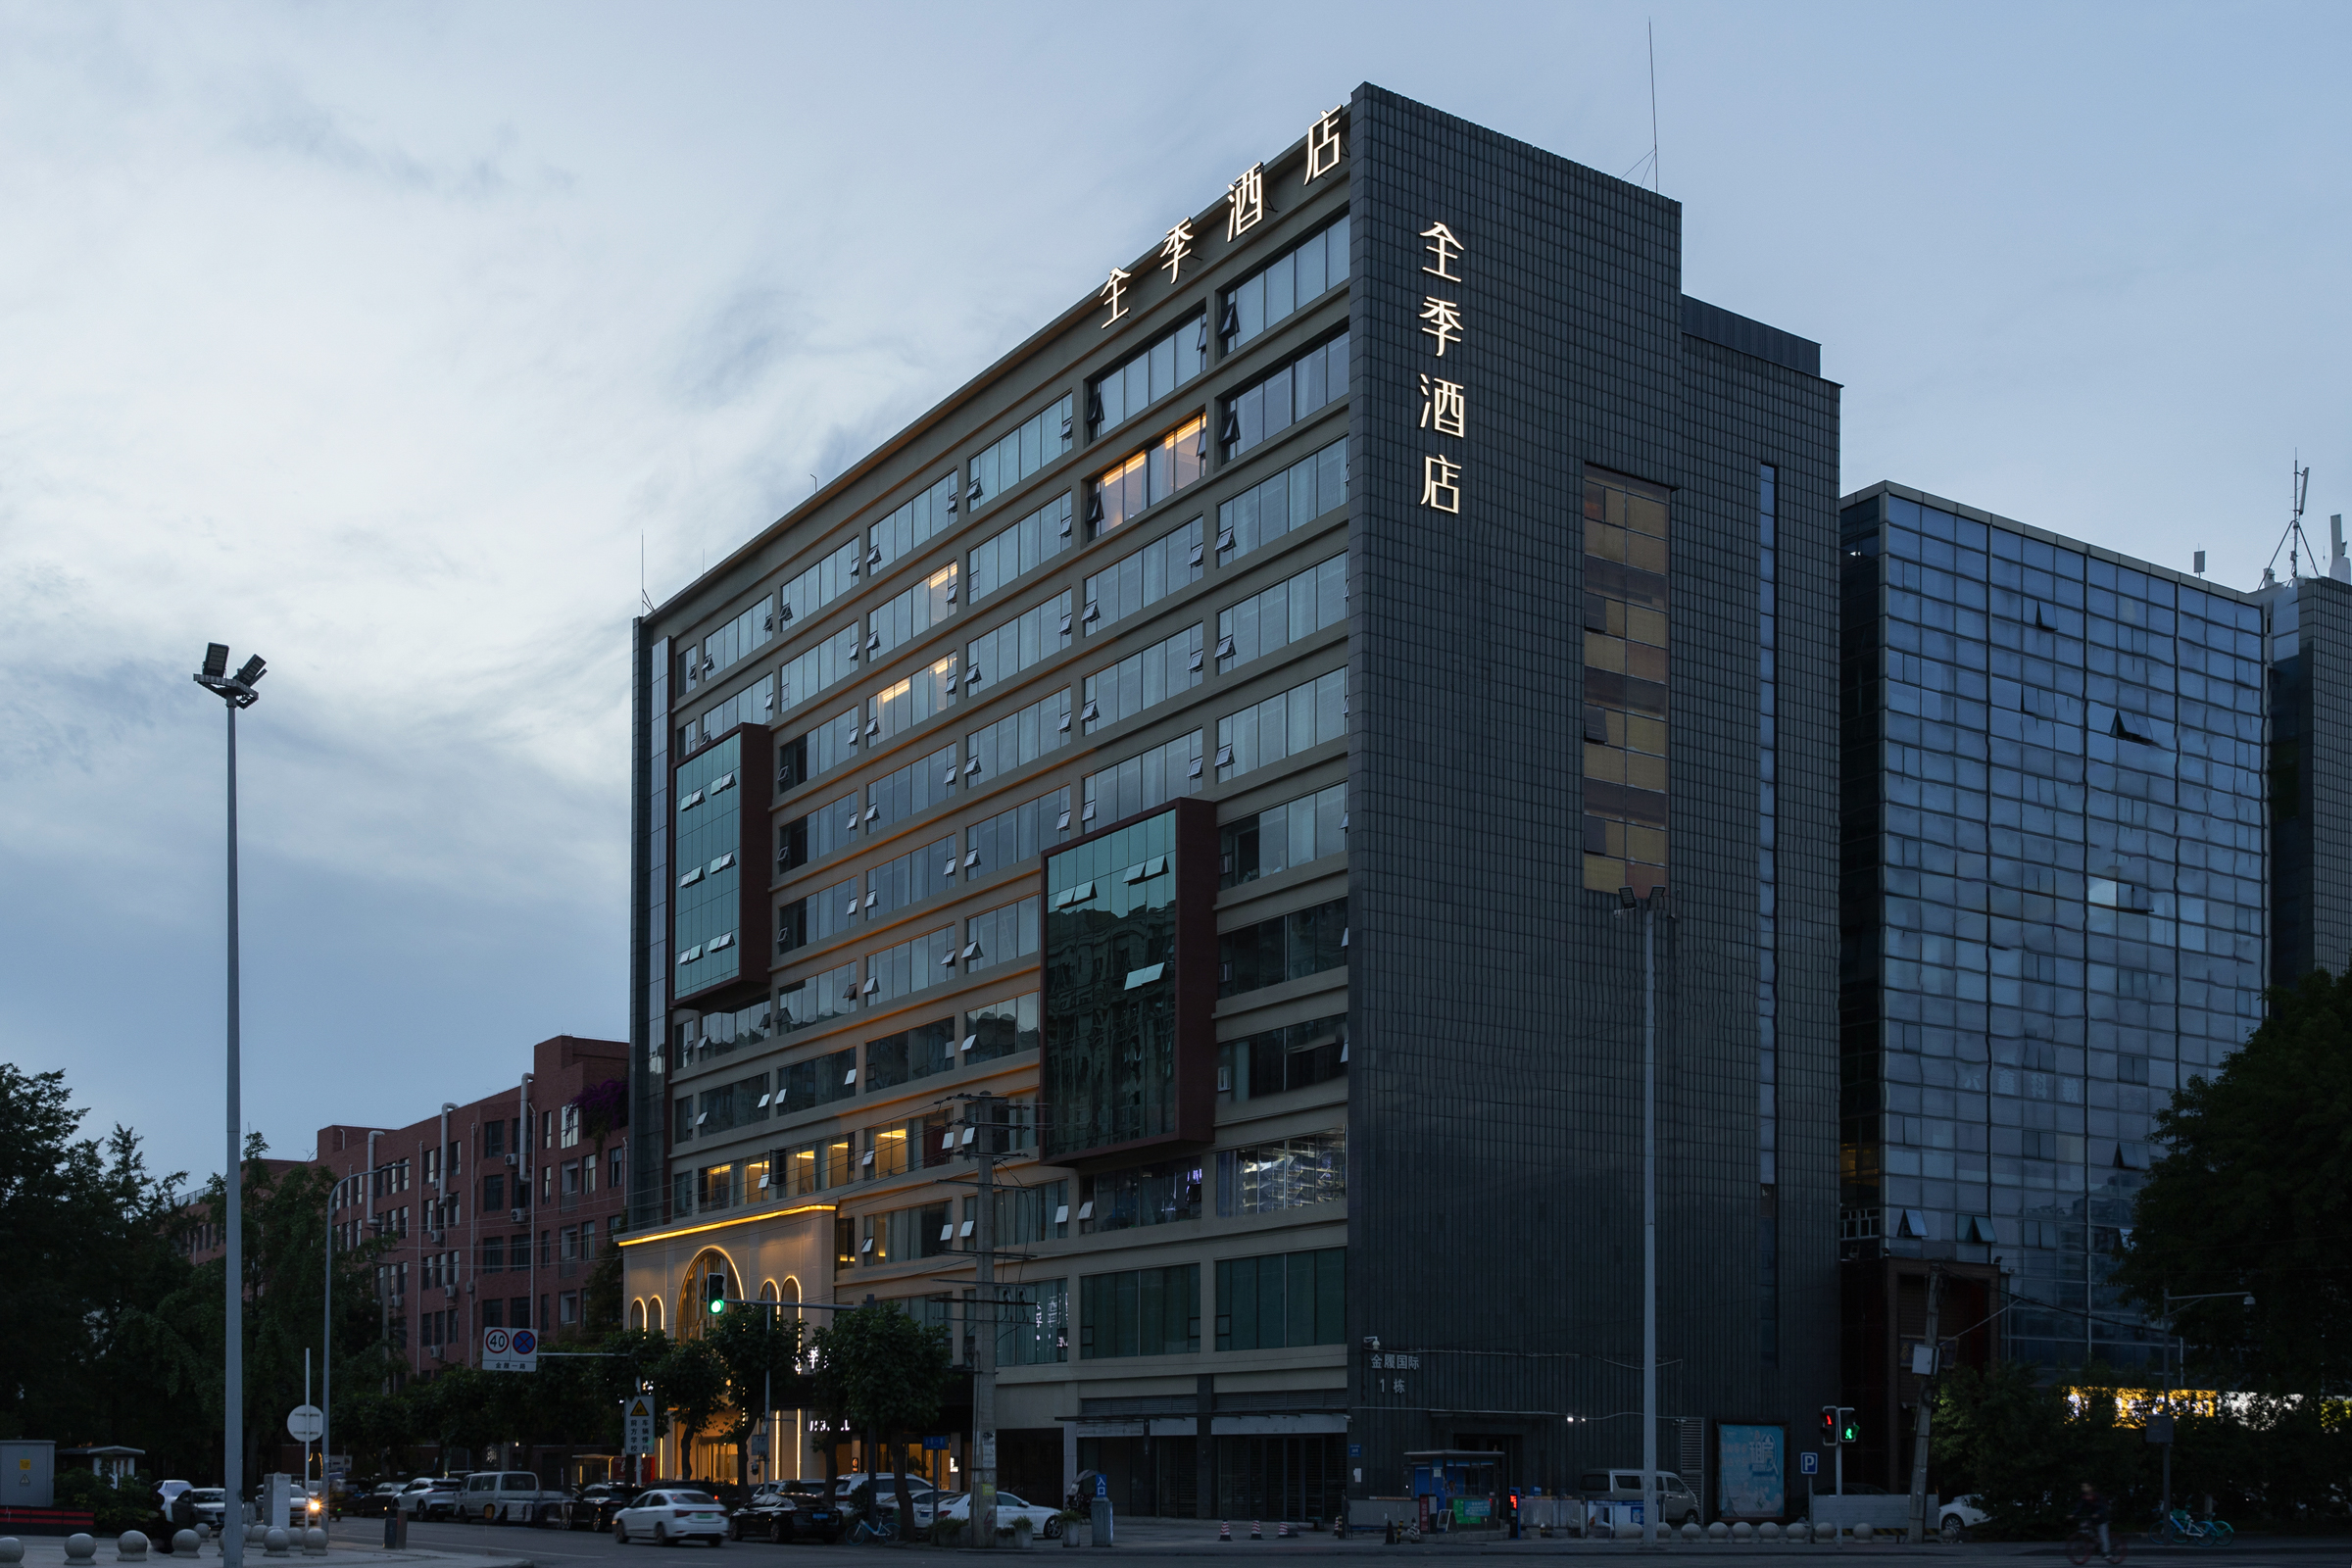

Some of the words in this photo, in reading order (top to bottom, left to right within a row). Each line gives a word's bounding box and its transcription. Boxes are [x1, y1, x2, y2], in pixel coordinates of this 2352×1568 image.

[1100, 103, 1345, 330] 全季酒店
[1418, 220, 1466, 515] 全季酒店
[489, 1335, 506, 1348] 40
[1371, 1353, 1420, 1370] 金履国际
[1804, 1455, 1815, 1471] P
[1098, 1477, 1105, 1495] 入口
